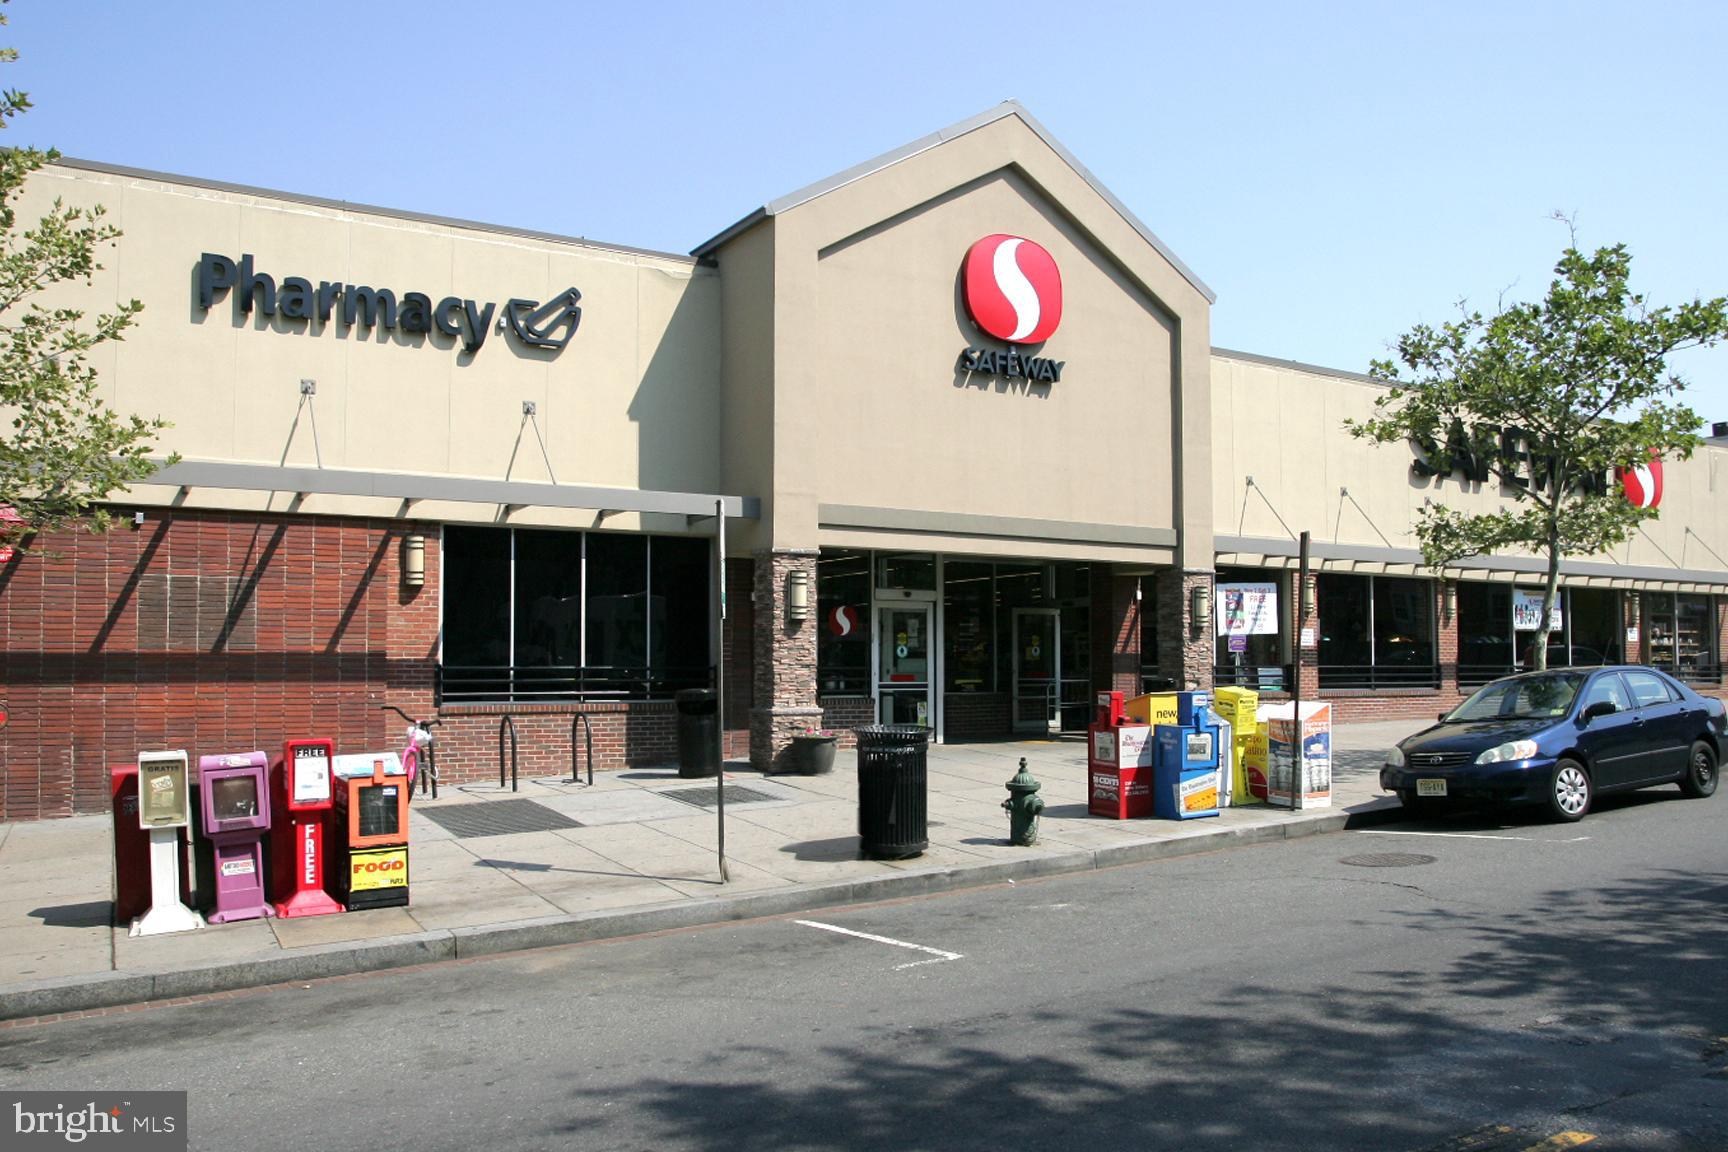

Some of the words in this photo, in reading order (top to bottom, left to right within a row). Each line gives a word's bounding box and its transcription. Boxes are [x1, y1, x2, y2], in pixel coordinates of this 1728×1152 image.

[200, 252, 496, 354] Pharmacy
[961, 347, 1066, 382] SAFEWAY
[296, 748, 325, 757] FREE
[304, 824, 316, 885] FREE
[353, 860, 404, 874] FOOD
